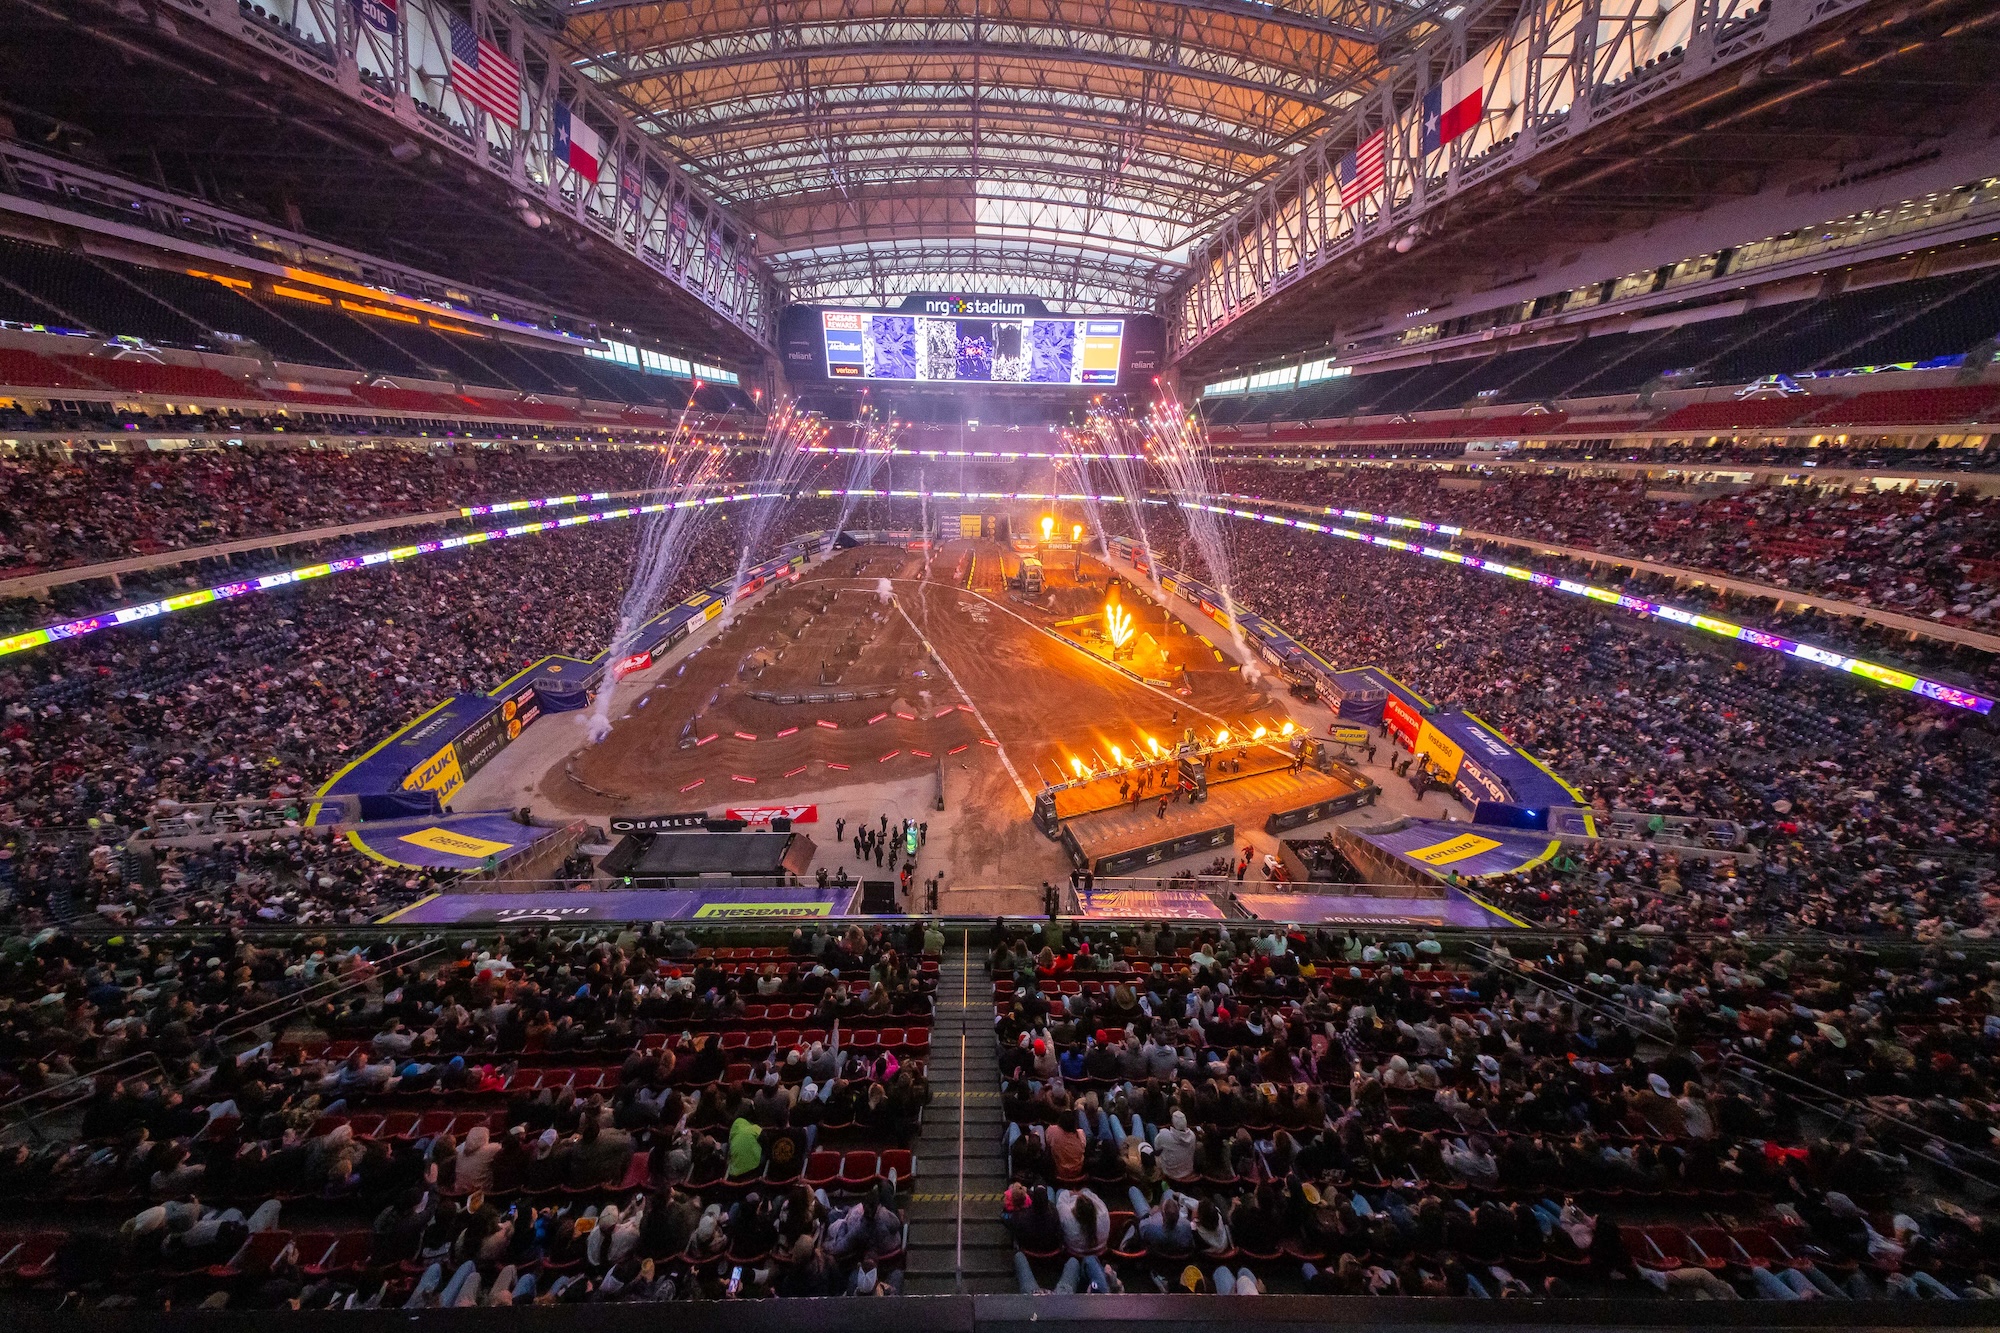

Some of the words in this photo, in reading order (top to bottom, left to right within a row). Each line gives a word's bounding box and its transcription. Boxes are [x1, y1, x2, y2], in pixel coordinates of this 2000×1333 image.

[362, 0, 387, 27] 2016
[926, 301, 950, 316] nrg
[966, 299, 1025, 314] stadium
[826, 314, 858, 322] CAESARS
[788, 352, 812, 360] reliant
[835, 366, 859, 374] verizon
[1131, 361, 1155, 369] reliant
[1395, 705, 1419, 730] HONDA
[463, 721, 491, 745] MONSTER
[1428, 732, 1452, 758] Insta360
[469, 741, 497, 766] MONSTER
[1463, 760, 1504, 803] FALKEN
[636, 817, 703, 830] OAKLEY
[1424, 842, 1474, 860] DUNLOP
[497, 908, 590, 916] OAKLEY
[705, 908, 820, 917] Kawasaki
[1324, 916, 1410, 925] COMMISSION
